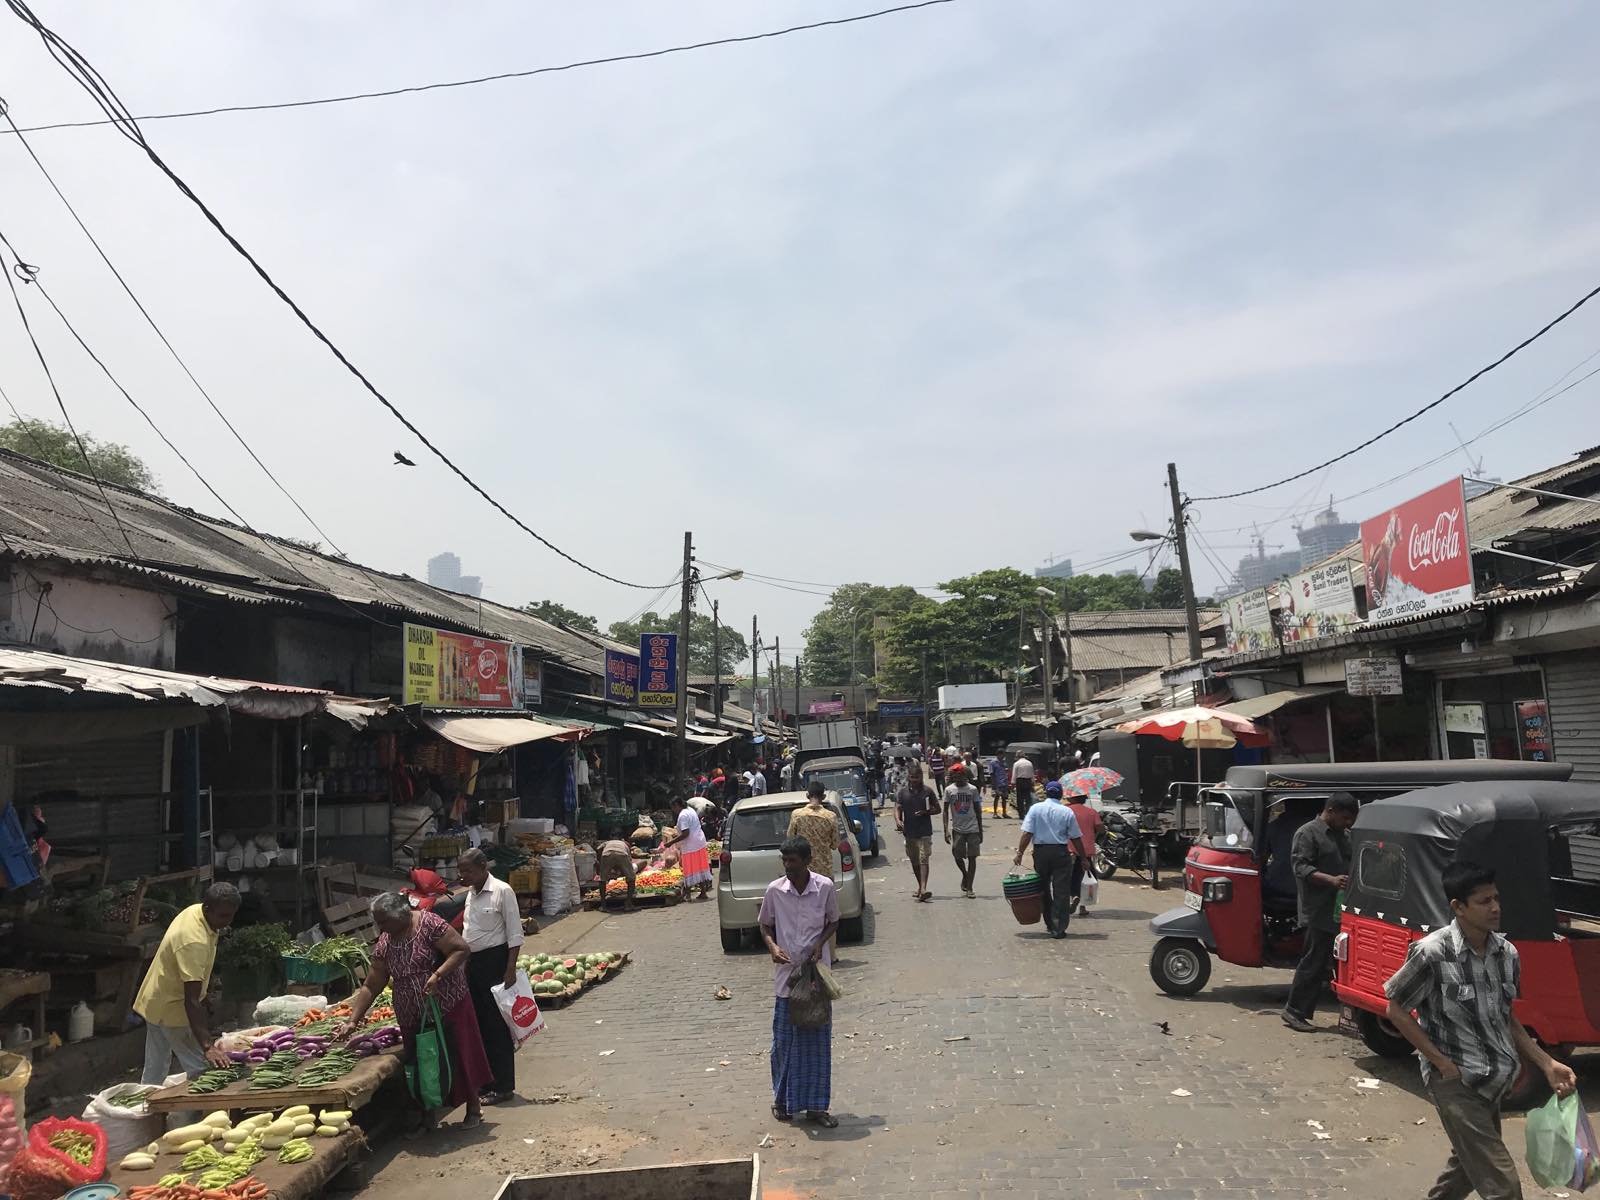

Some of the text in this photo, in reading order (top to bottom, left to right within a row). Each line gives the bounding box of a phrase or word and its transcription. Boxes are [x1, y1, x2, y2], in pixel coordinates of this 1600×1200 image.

[1408, 508, 1461, 571] Coca-Cola
[1327, 575, 1349, 587] Traders
[408, 627, 433, 646] DHAKSHA
[409, 661, 434, 678] MARKETING
